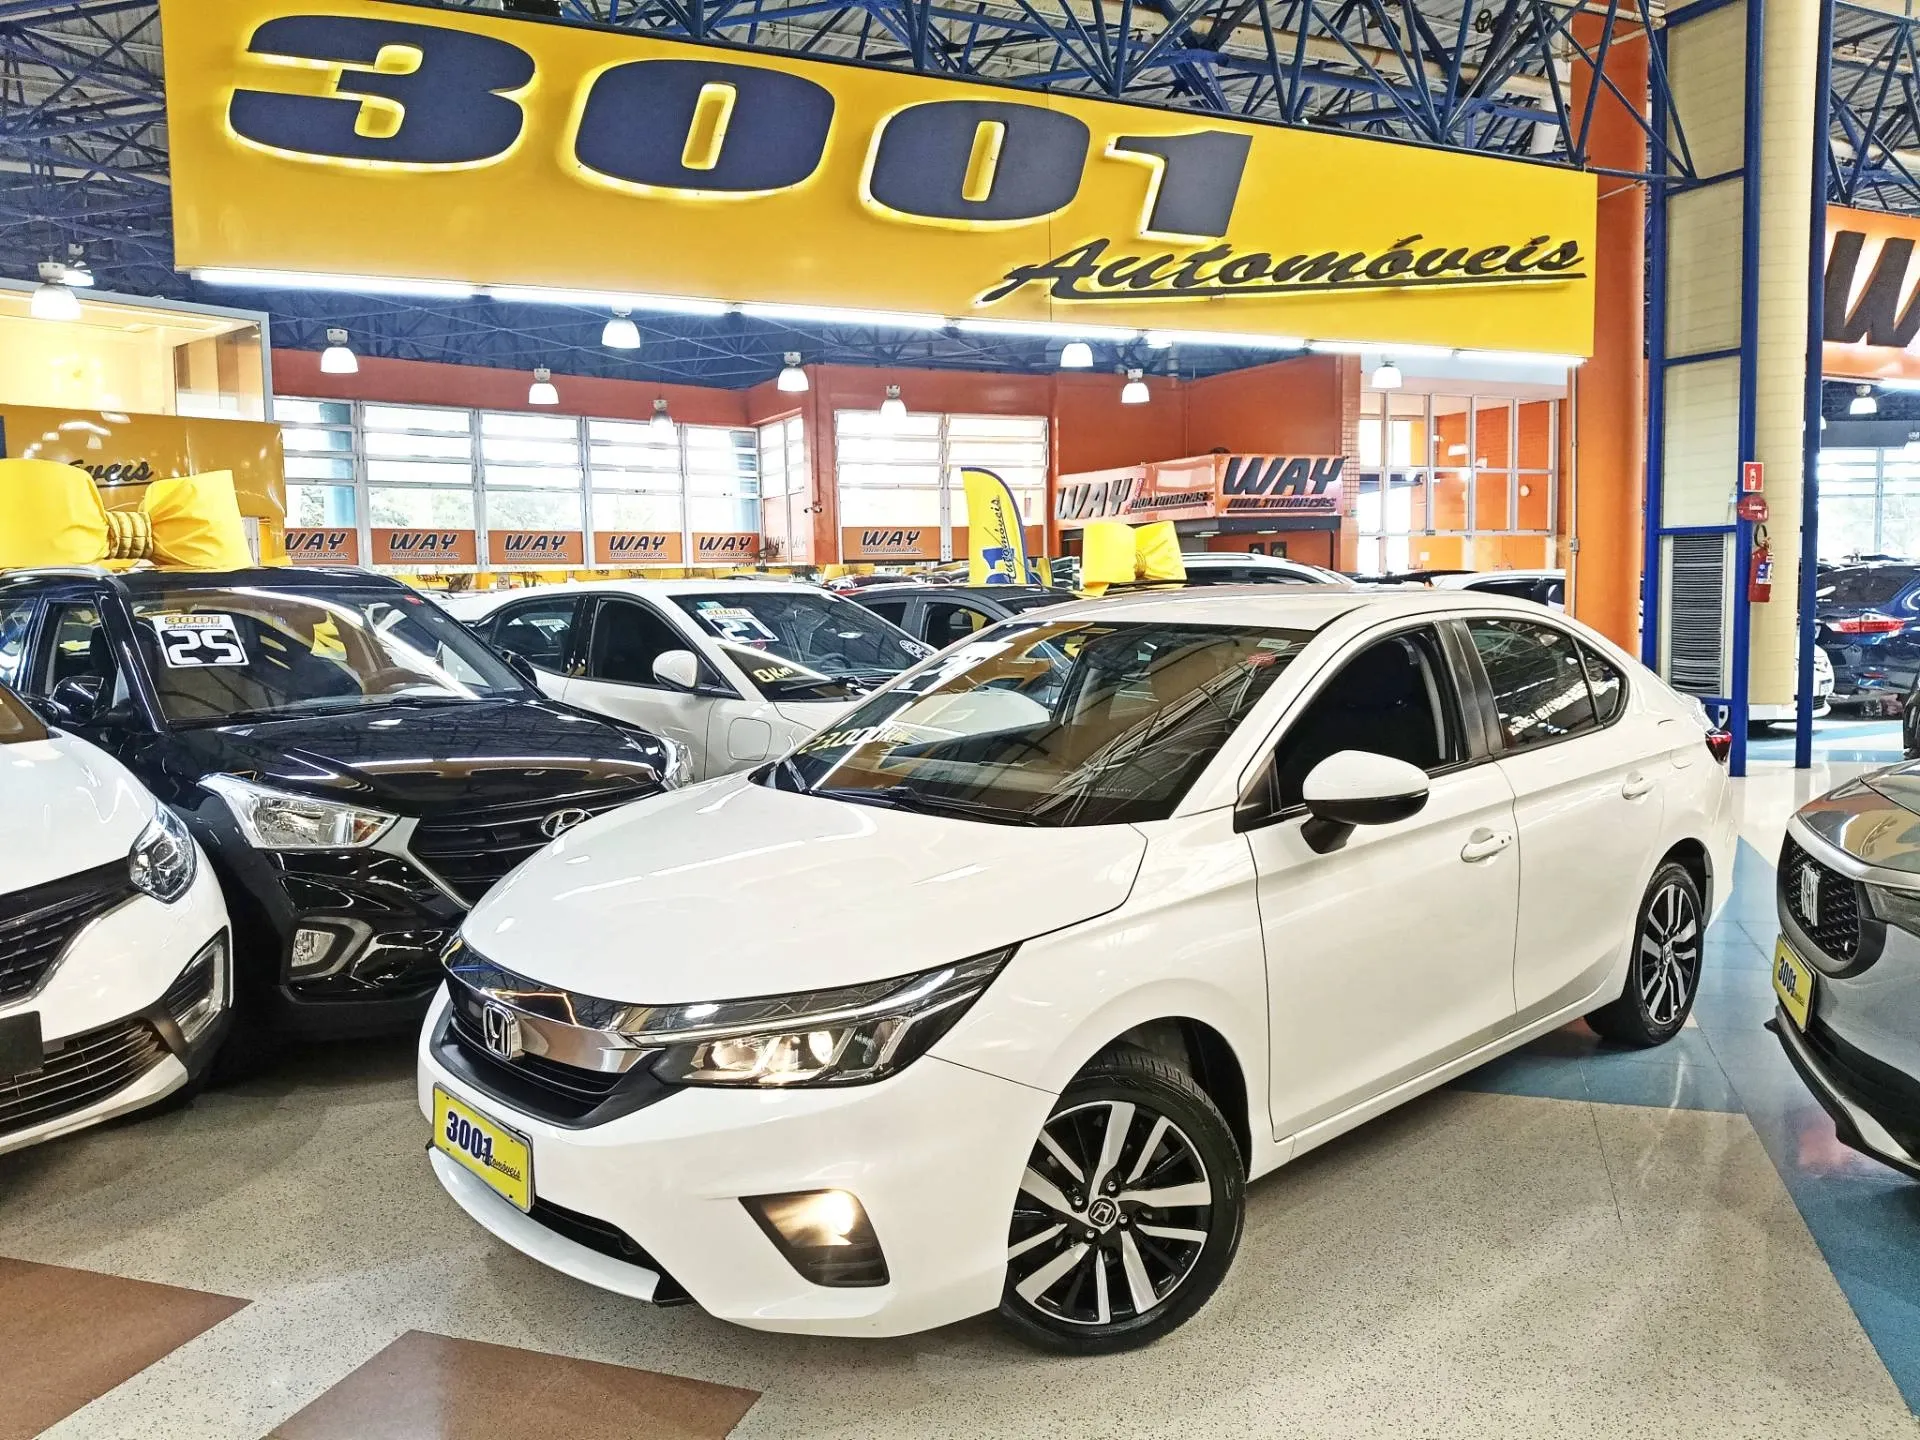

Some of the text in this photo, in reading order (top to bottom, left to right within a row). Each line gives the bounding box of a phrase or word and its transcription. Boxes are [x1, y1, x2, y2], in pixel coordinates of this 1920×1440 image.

[230, 14, 1253, 238] 3001
[980, 234, 1587, 302] Automóveis
[1224, 456, 1345, 495] WAY
[1055, 478, 1133, 520] WAY
[389, 532, 458, 550] WAY
[504, 534, 567, 551] WAY
[609, 535, 666, 551] WAY
[699, 535, 752, 551] WAY
[861, 530, 921, 546] WAY
[166, 629, 243, 665] 25
[1778, 957, 1797, 996] 3001
[446, 1111, 493, 1167] 3001
